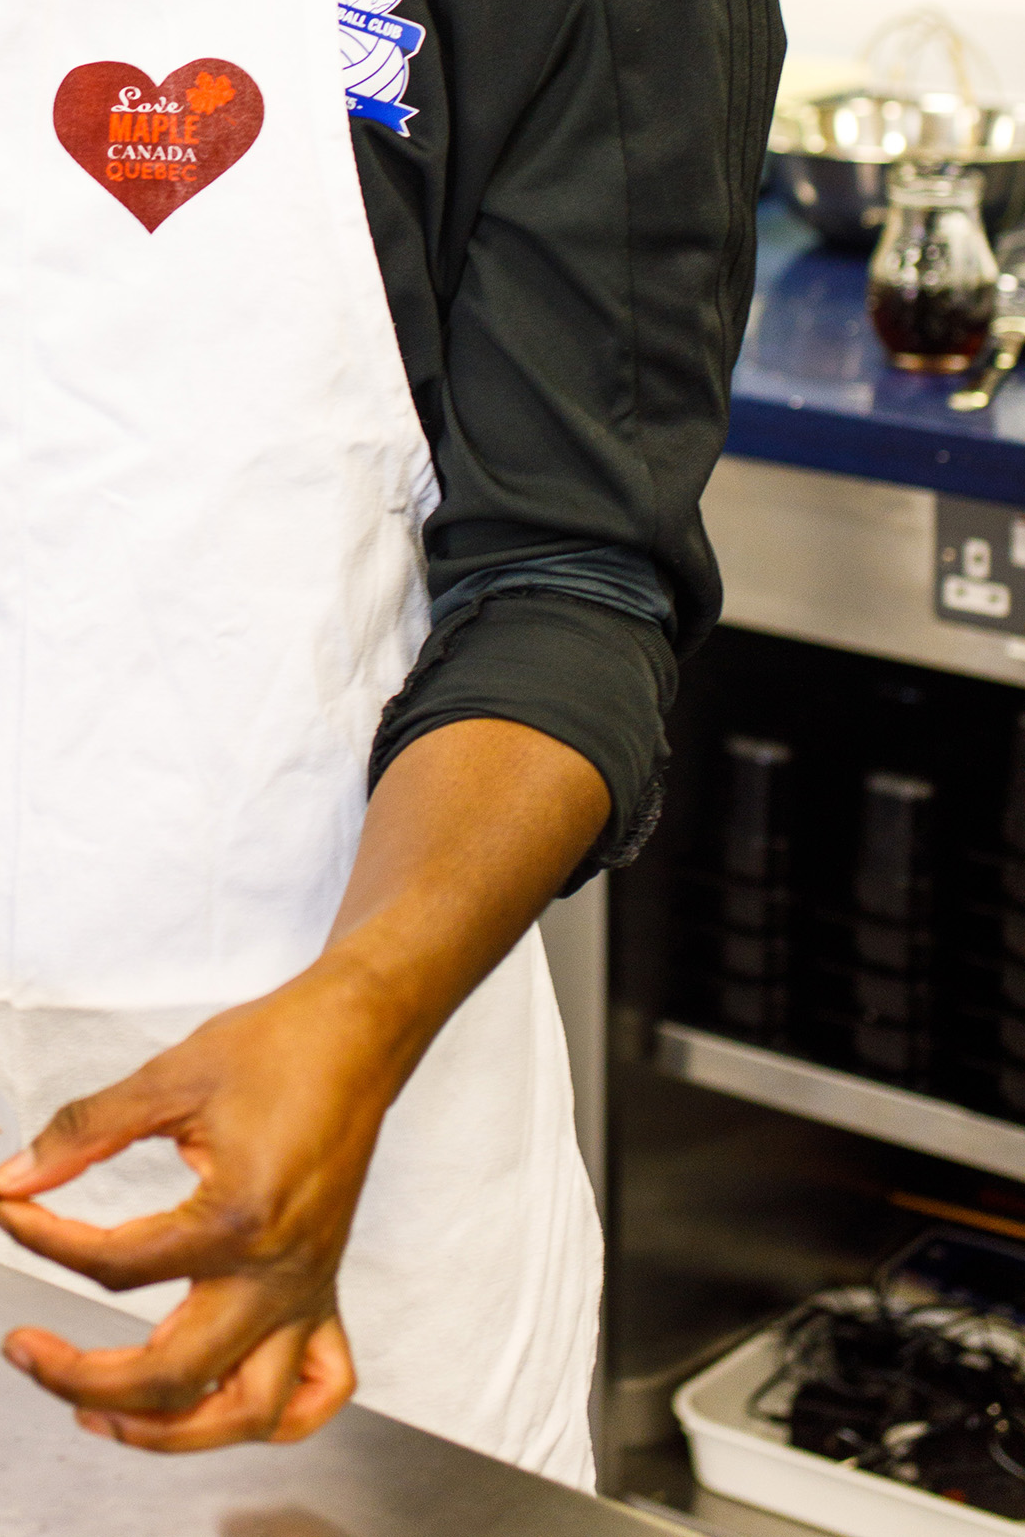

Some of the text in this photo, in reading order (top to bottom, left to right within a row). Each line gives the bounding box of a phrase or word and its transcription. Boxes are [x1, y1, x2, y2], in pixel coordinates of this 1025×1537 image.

[367, 17, 404, 40] CLUB
[110, 86, 185, 113] Love
[108, 113, 200, 144] MAPLE
[107, 144, 197, 162] CANADA
[105, 161, 197, 182] QUEBEC
